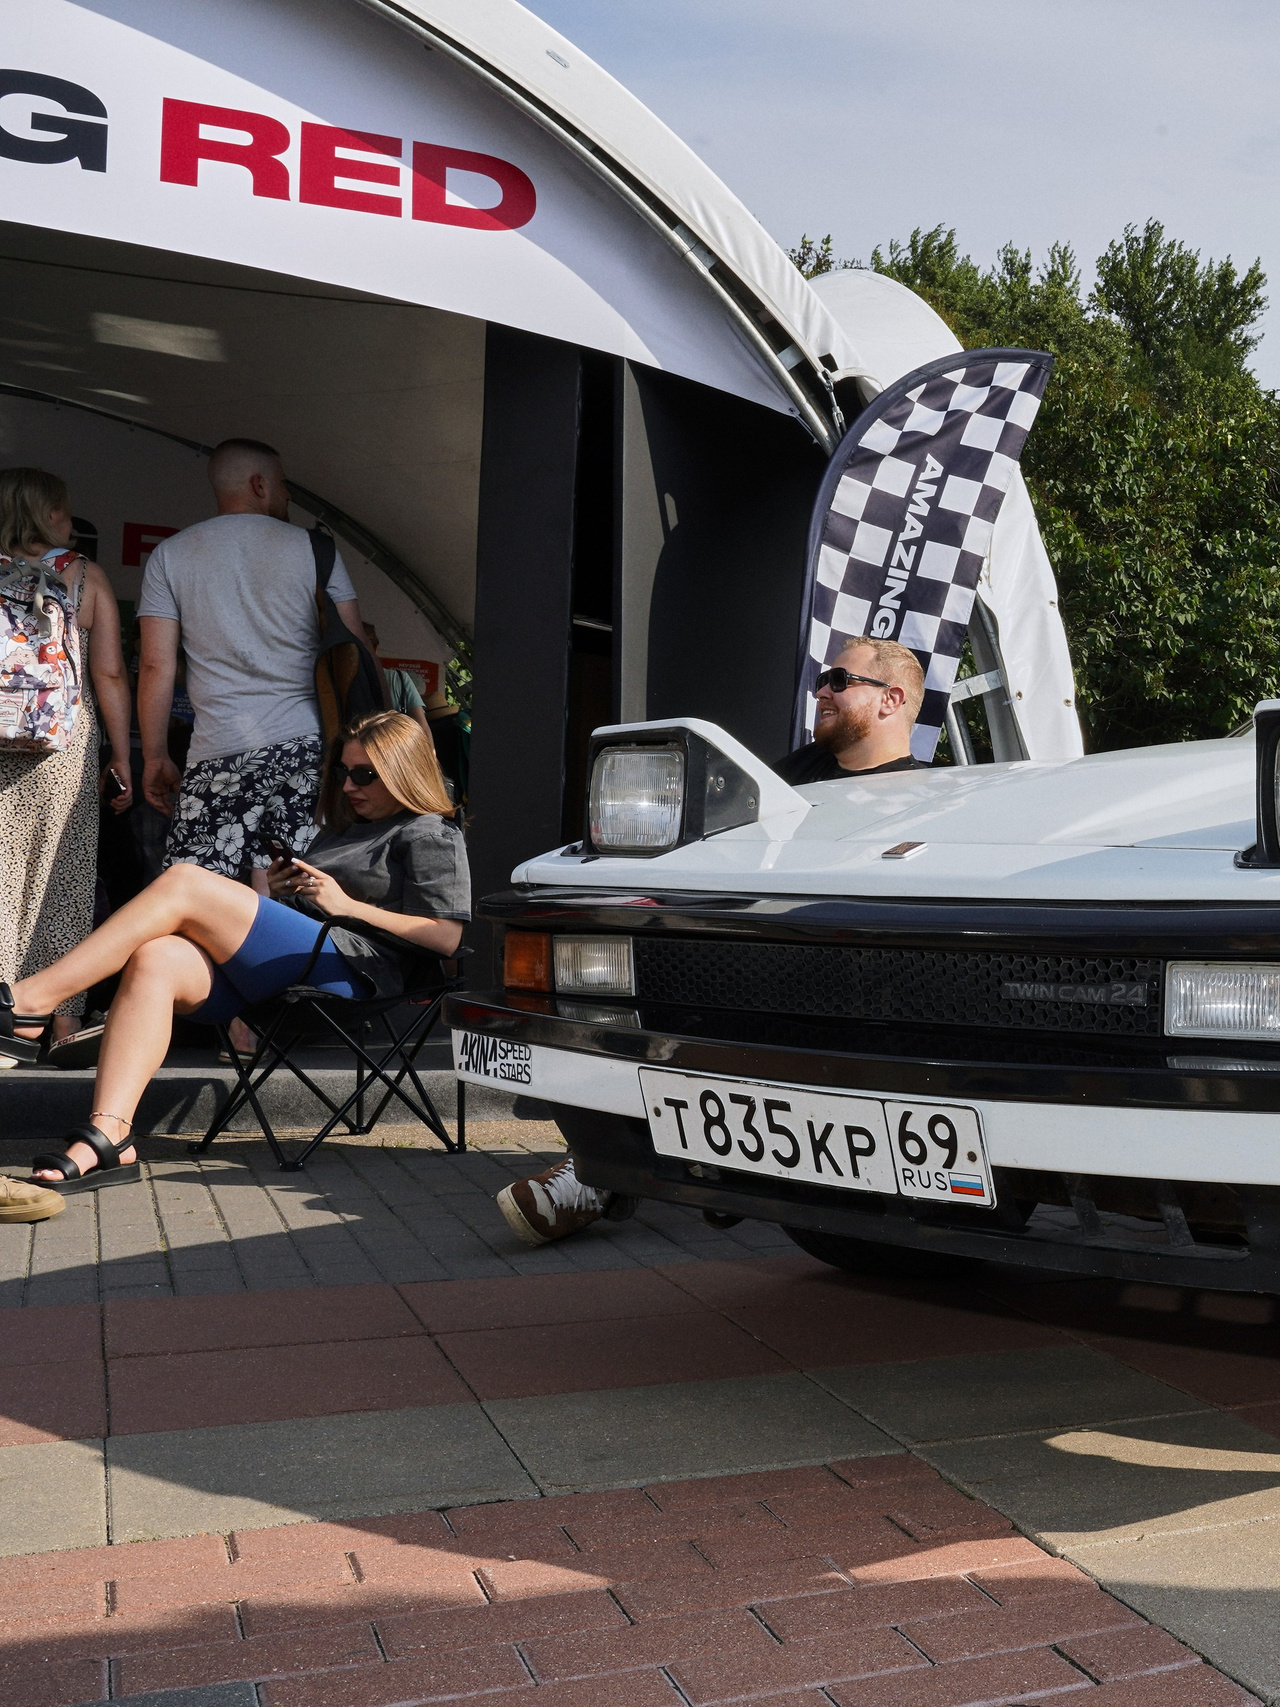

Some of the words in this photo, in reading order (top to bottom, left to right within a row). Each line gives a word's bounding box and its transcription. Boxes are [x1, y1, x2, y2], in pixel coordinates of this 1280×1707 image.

[160, 97, 537, 231] RED
[870, 453, 944, 639] AMAZING
[1004, 981, 1054, 999] TWIN
[1058, 985, 1104, 1002] CAM
[1111, 983, 1143, 1003] 24
[458, 1032, 498, 1078] AKINA
[498, 1039, 531, 1061] SPEED
[499, 1063, 531, 1084] STARS
[898, 1110, 959, 1169] 69
[902, 1167, 948, 1191] RUS
